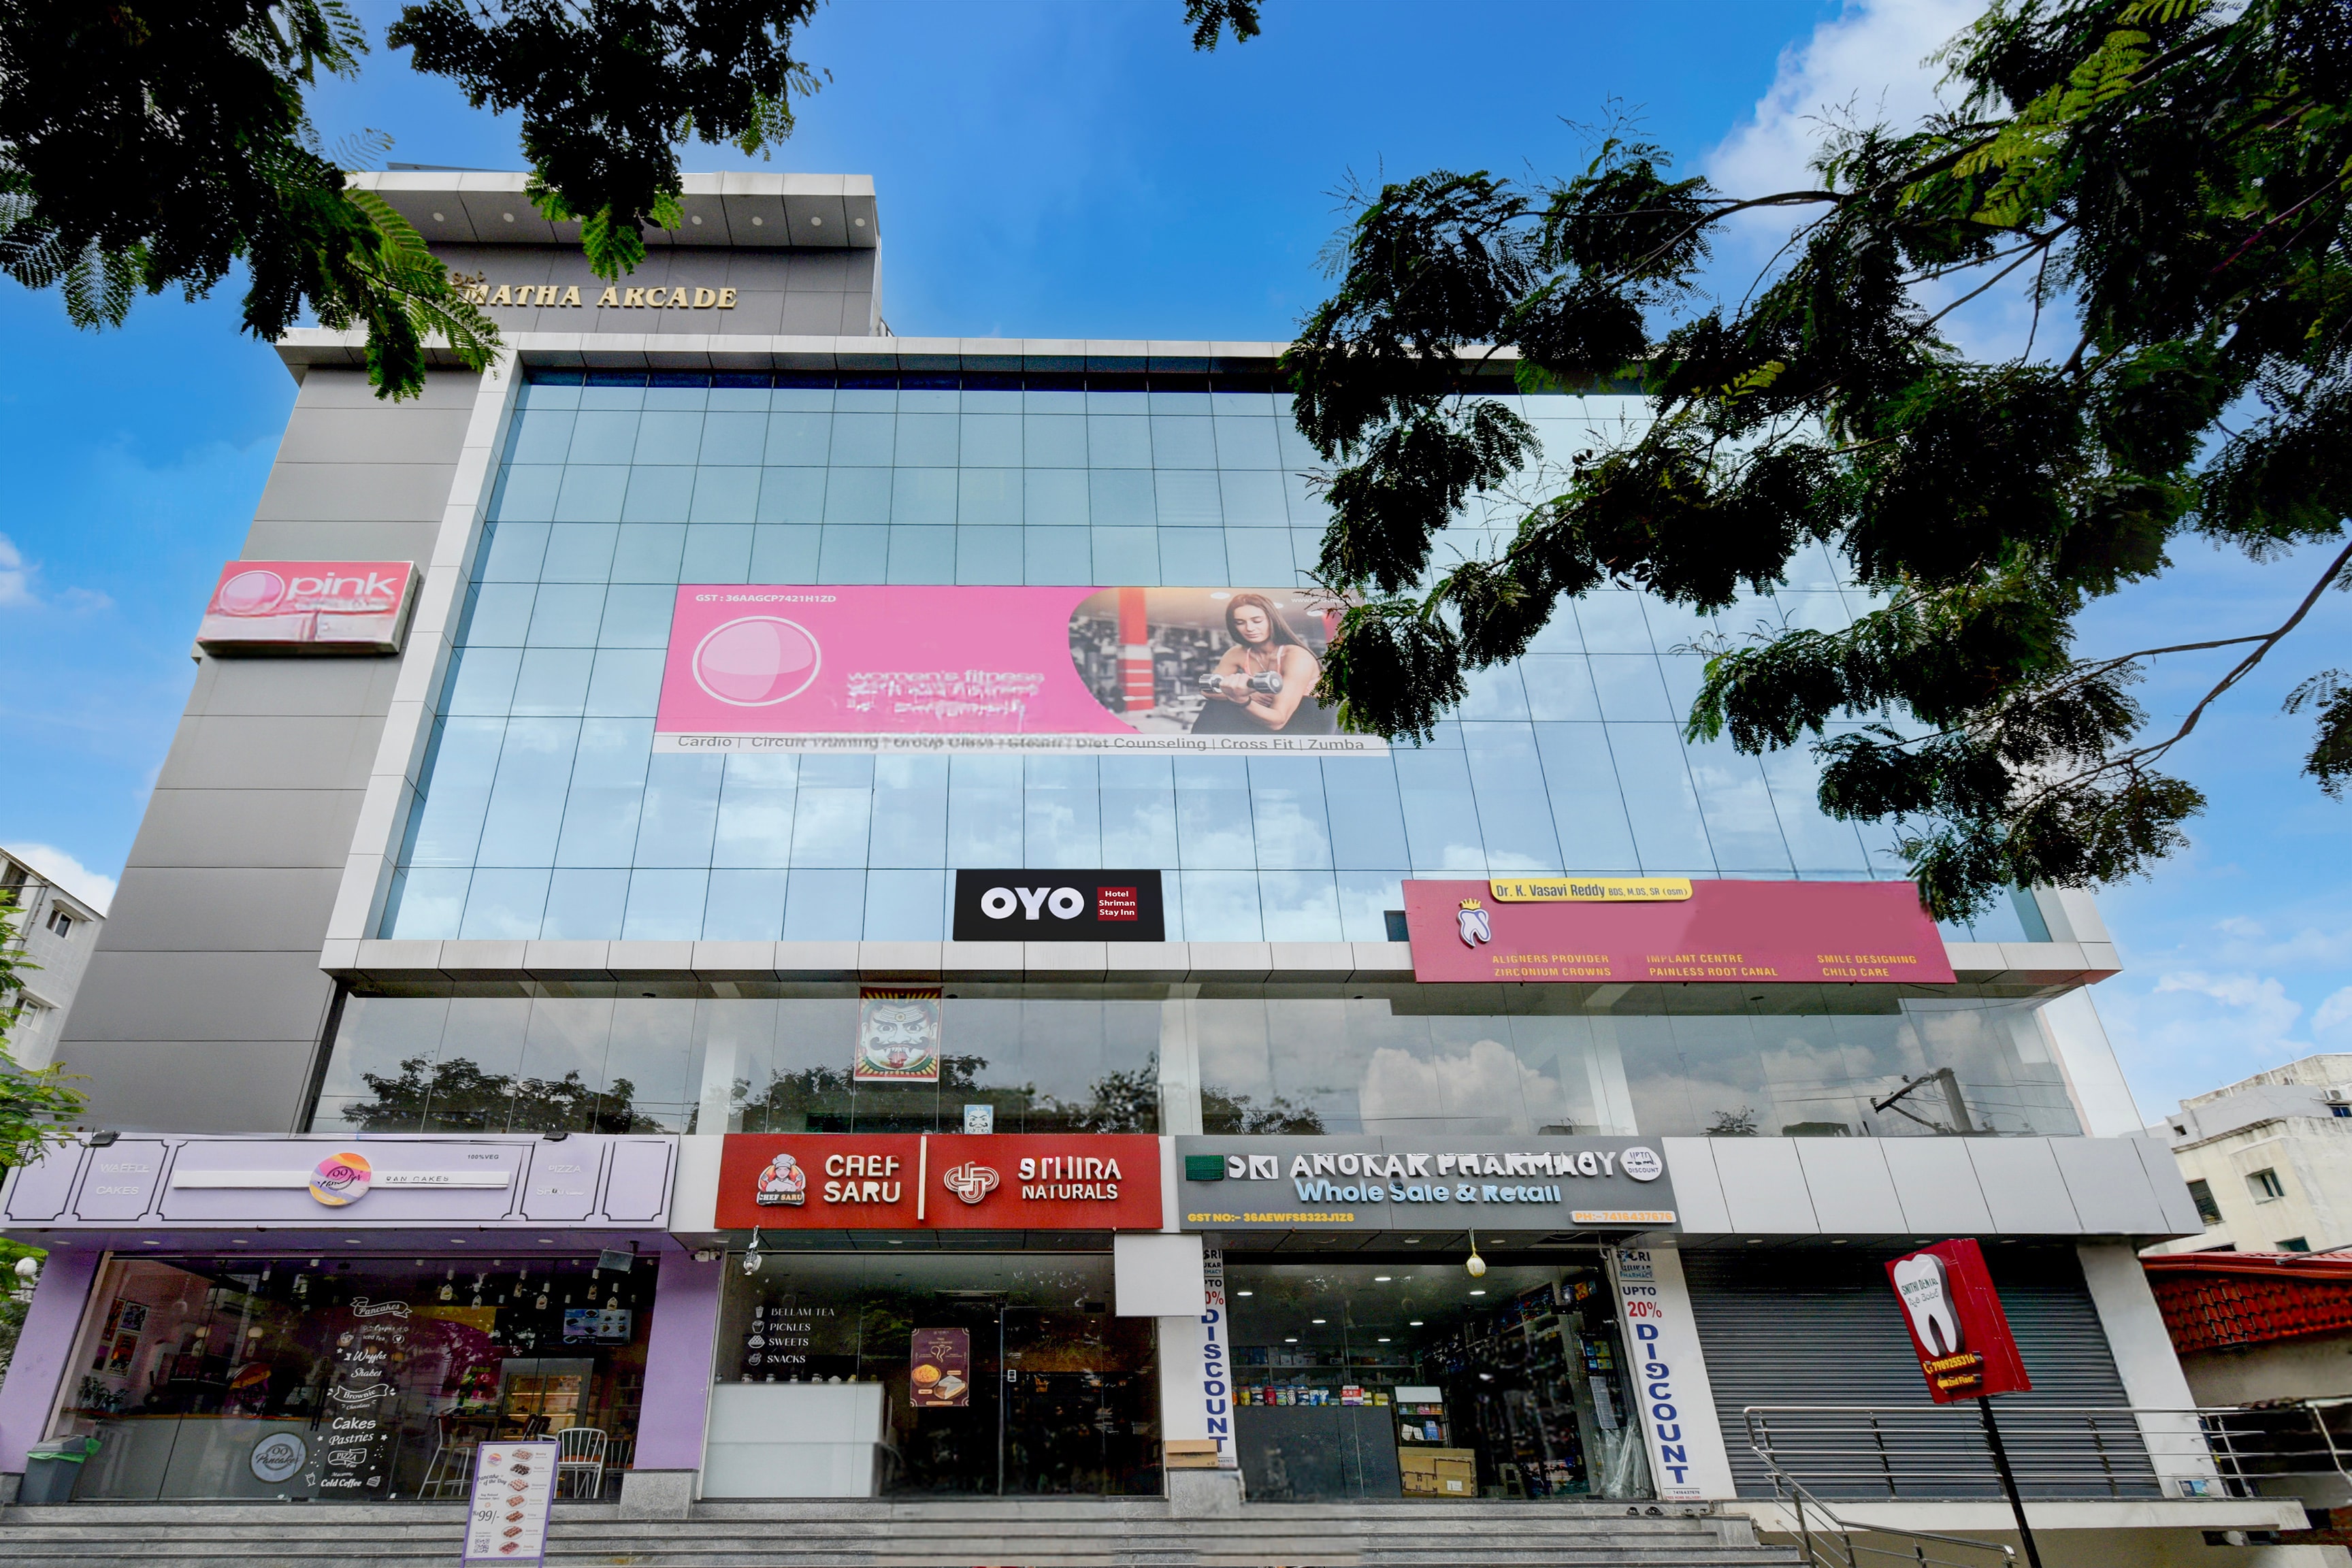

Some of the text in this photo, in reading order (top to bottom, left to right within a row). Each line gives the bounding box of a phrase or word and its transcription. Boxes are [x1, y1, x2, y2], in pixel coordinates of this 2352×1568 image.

[596, 286, 738, 309] ARCADE
[287, 572, 398, 600] pink
[696, 594, 717, 602] GST
[678, 736, 732, 747] Cardio
[1077, 738, 1109, 748] Diet
[1113, 738, 1207, 751] Counseling
[1220, 738, 1267, 749] Cross
[1273, 738, 1294, 749] Fit
[1308, 738, 1364, 750] Zumba
[1497, 885, 1513, 896] Dr.
[1516, 885, 1526, 896] K.
[1529, 884, 1567, 896] Vasavi
[1571, 884, 1605, 898] Reddy
[1650, 887, 1659, 896] SR
[981, 887, 1085, 919] OYO
[1100, 909, 1118, 917] Stay
[1492, 955, 1609, 963] ALIGNERS PROVIDER
[1646, 954, 1744, 963] IMPLANT CENTRE
[1818, 955, 1917, 964] SMILE DESIGNING
[1494, 967, 1612, 976] ZIRCONIUM CROWNS
[1649, 967, 1778, 977] PAINLESS ROOT CANAL
[1823, 967, 1889, 977] CHILD CARE
[825, 1154, 899, 1177] CHEF
[96, 1186, 139, 1195] CAKES
[823, 1181, 900, 1203] SARU
[1022, 1183, 1118, 1200] NATURALS
[1294, 1177, 1384, 1203] Whole
[1389, 1181, 1450, 1203] Sale
[1188, 1213, 1211, 1222] GST
[1622, 1286, 1656, 1296] UPTO
[1206, 1291, 1224, 1305] 0%
[359, 1303, 400, 1315] Pancakes
[771, 1308, 834, 1316] BELLAM TEA
[1627, 1301, 1662, 1318] 20%
[770, 1323, 811, 1331] PICKLES
[768, 1338, 808, 1346] SWEETS
[353, 1350, 387, 1363] Waffles
[767, 1355, 806, 1363] SNACKS
[350, 1367, 382, 1378] Shakes
[1958, 1376, 1975, 1384] Floor
[343, 1390, 376, 1399] Brownie
[332, 1417, 376, 1430] Cakes
[329, 1432, 374, 1446] Pastries
[337, 1452, 357, 1461] PIZZA
[321, 1478, 362, 1488] Cold Coffee
